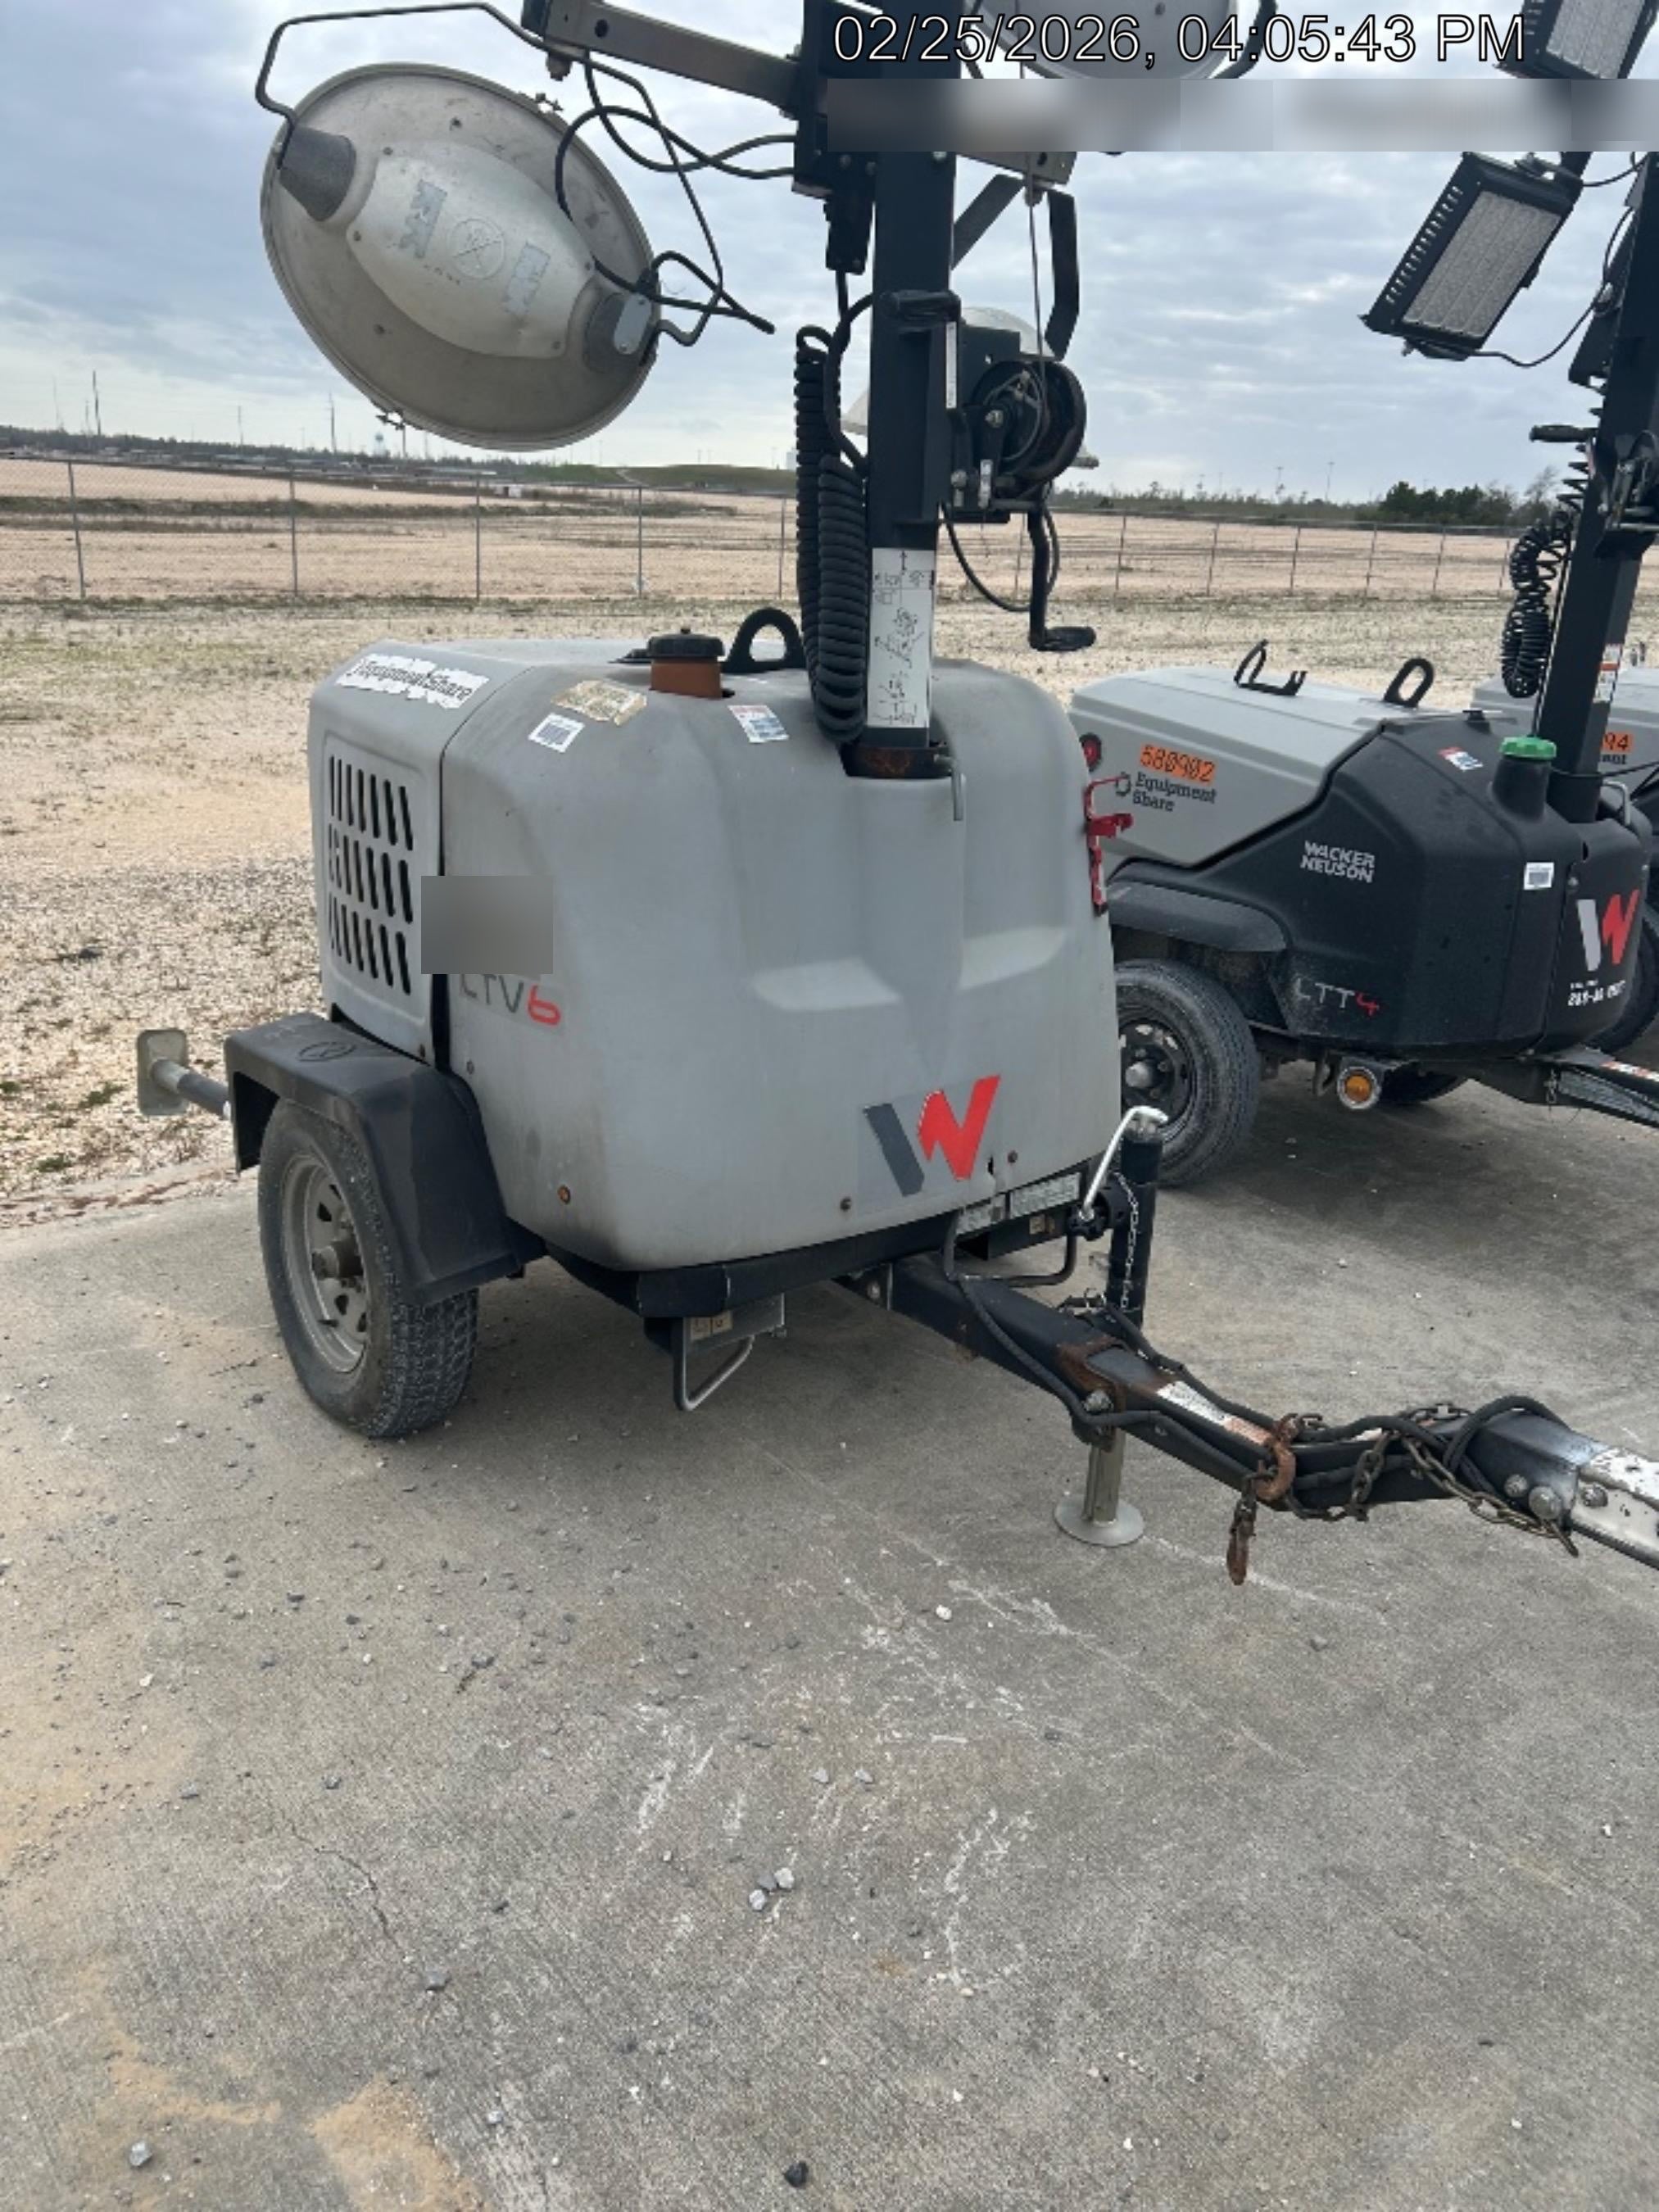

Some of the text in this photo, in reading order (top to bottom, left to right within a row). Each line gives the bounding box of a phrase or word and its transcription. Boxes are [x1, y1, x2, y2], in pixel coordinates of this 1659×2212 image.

[1132, 789, 1176, 812] Share
[1135, 771, 1217, 805] Equipment
[1299, 854, 1375, 884] NEUSON
[1303, 840, 1376, 869] WACKER
[1294, 977, 1380, 1017] LTT4
